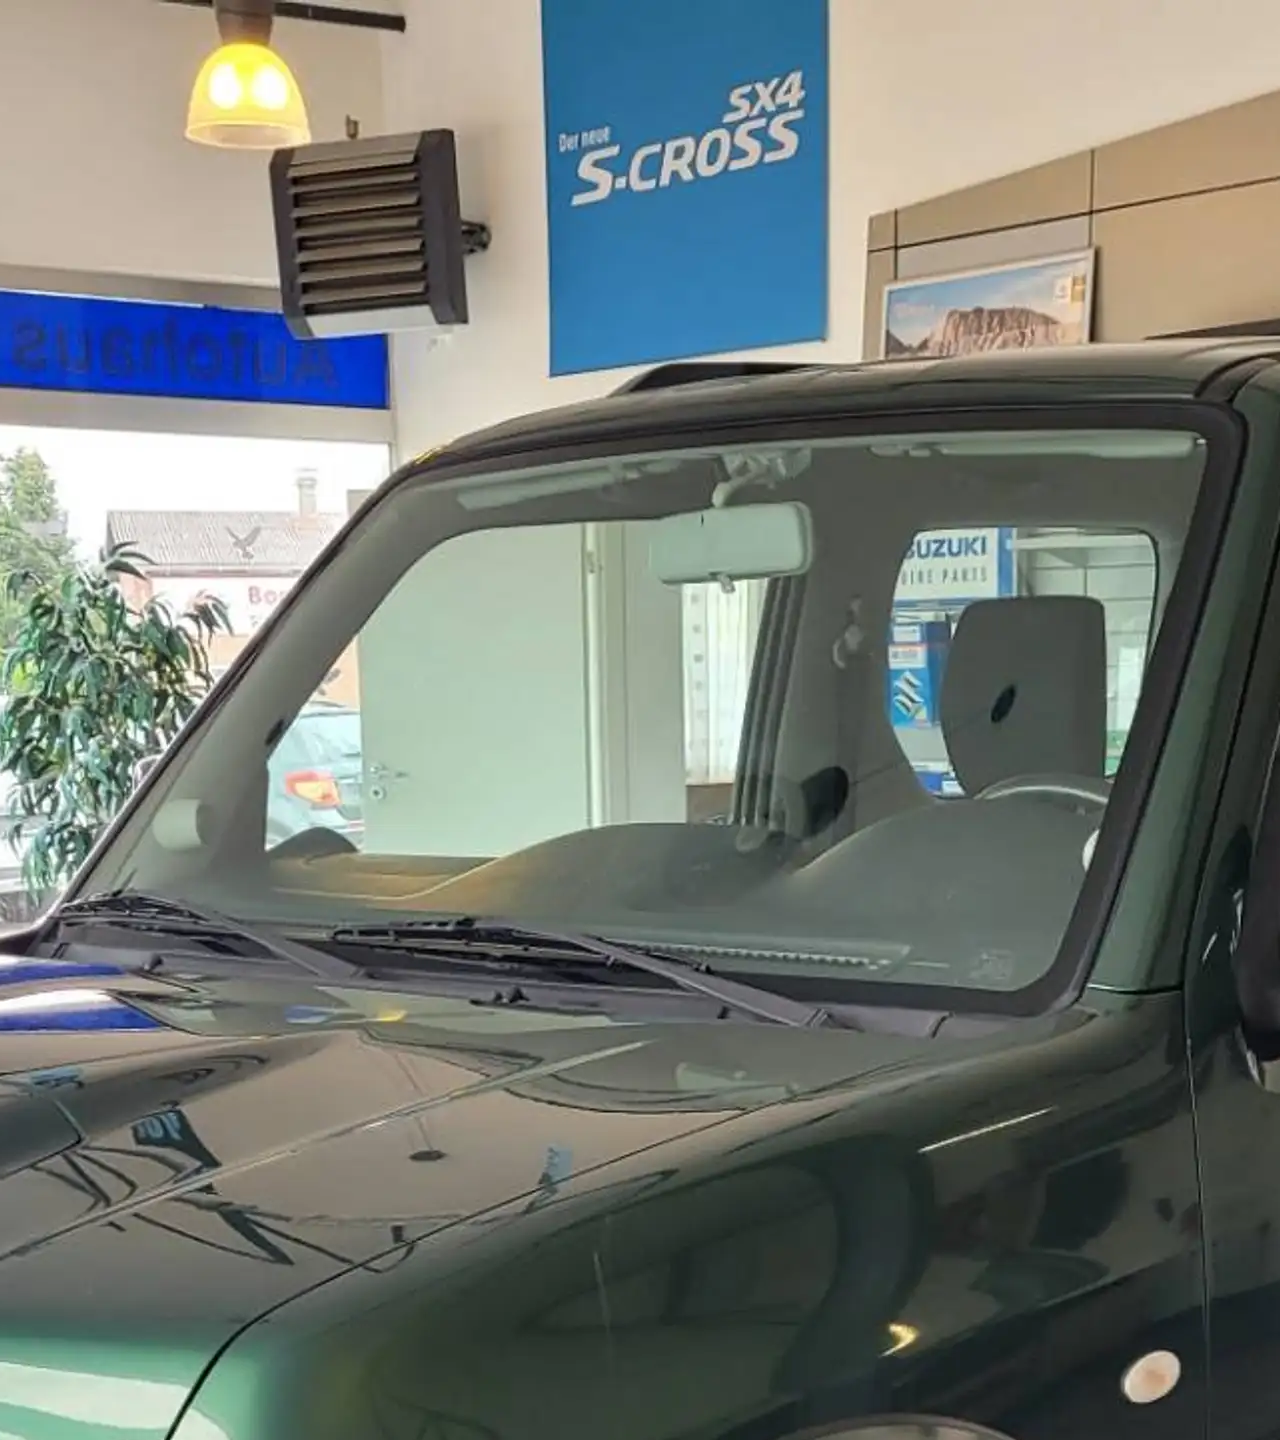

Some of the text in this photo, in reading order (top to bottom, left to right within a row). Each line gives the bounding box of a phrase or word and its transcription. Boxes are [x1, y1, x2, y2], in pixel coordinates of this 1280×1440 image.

[722, 69, 806, 124] SX4
[559, 126, 611, 152] Der neue
[942, 566, 988, 583] PARTS
